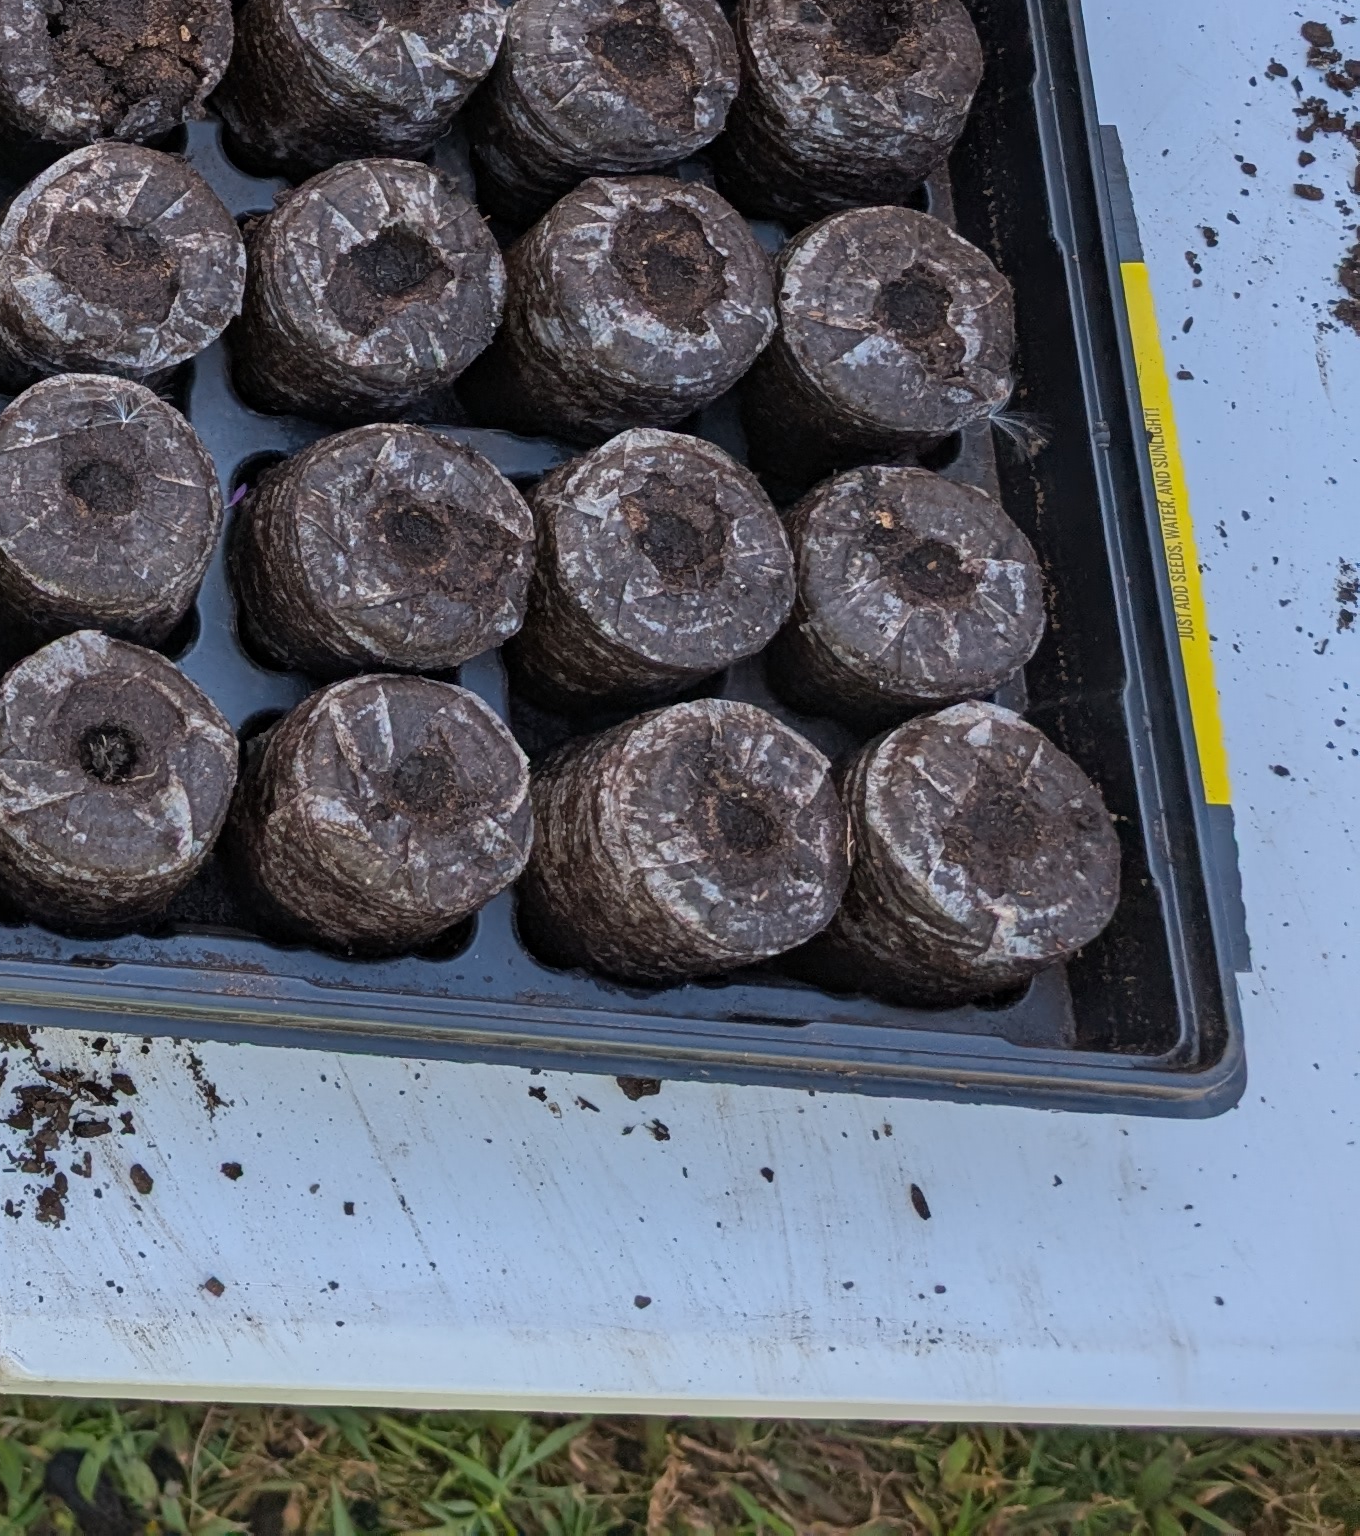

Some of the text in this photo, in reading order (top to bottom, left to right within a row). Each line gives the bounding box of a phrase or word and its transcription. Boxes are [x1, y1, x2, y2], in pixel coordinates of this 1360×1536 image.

[1157, 471, 1174, 496] AND
[1160, 497, 1181, 541] WATER,
[1167, 541, 1187, 582] SEEDS,
[1172, 585, 1190, 610] ADD
[1177, 612, 1195, 641] JUST
